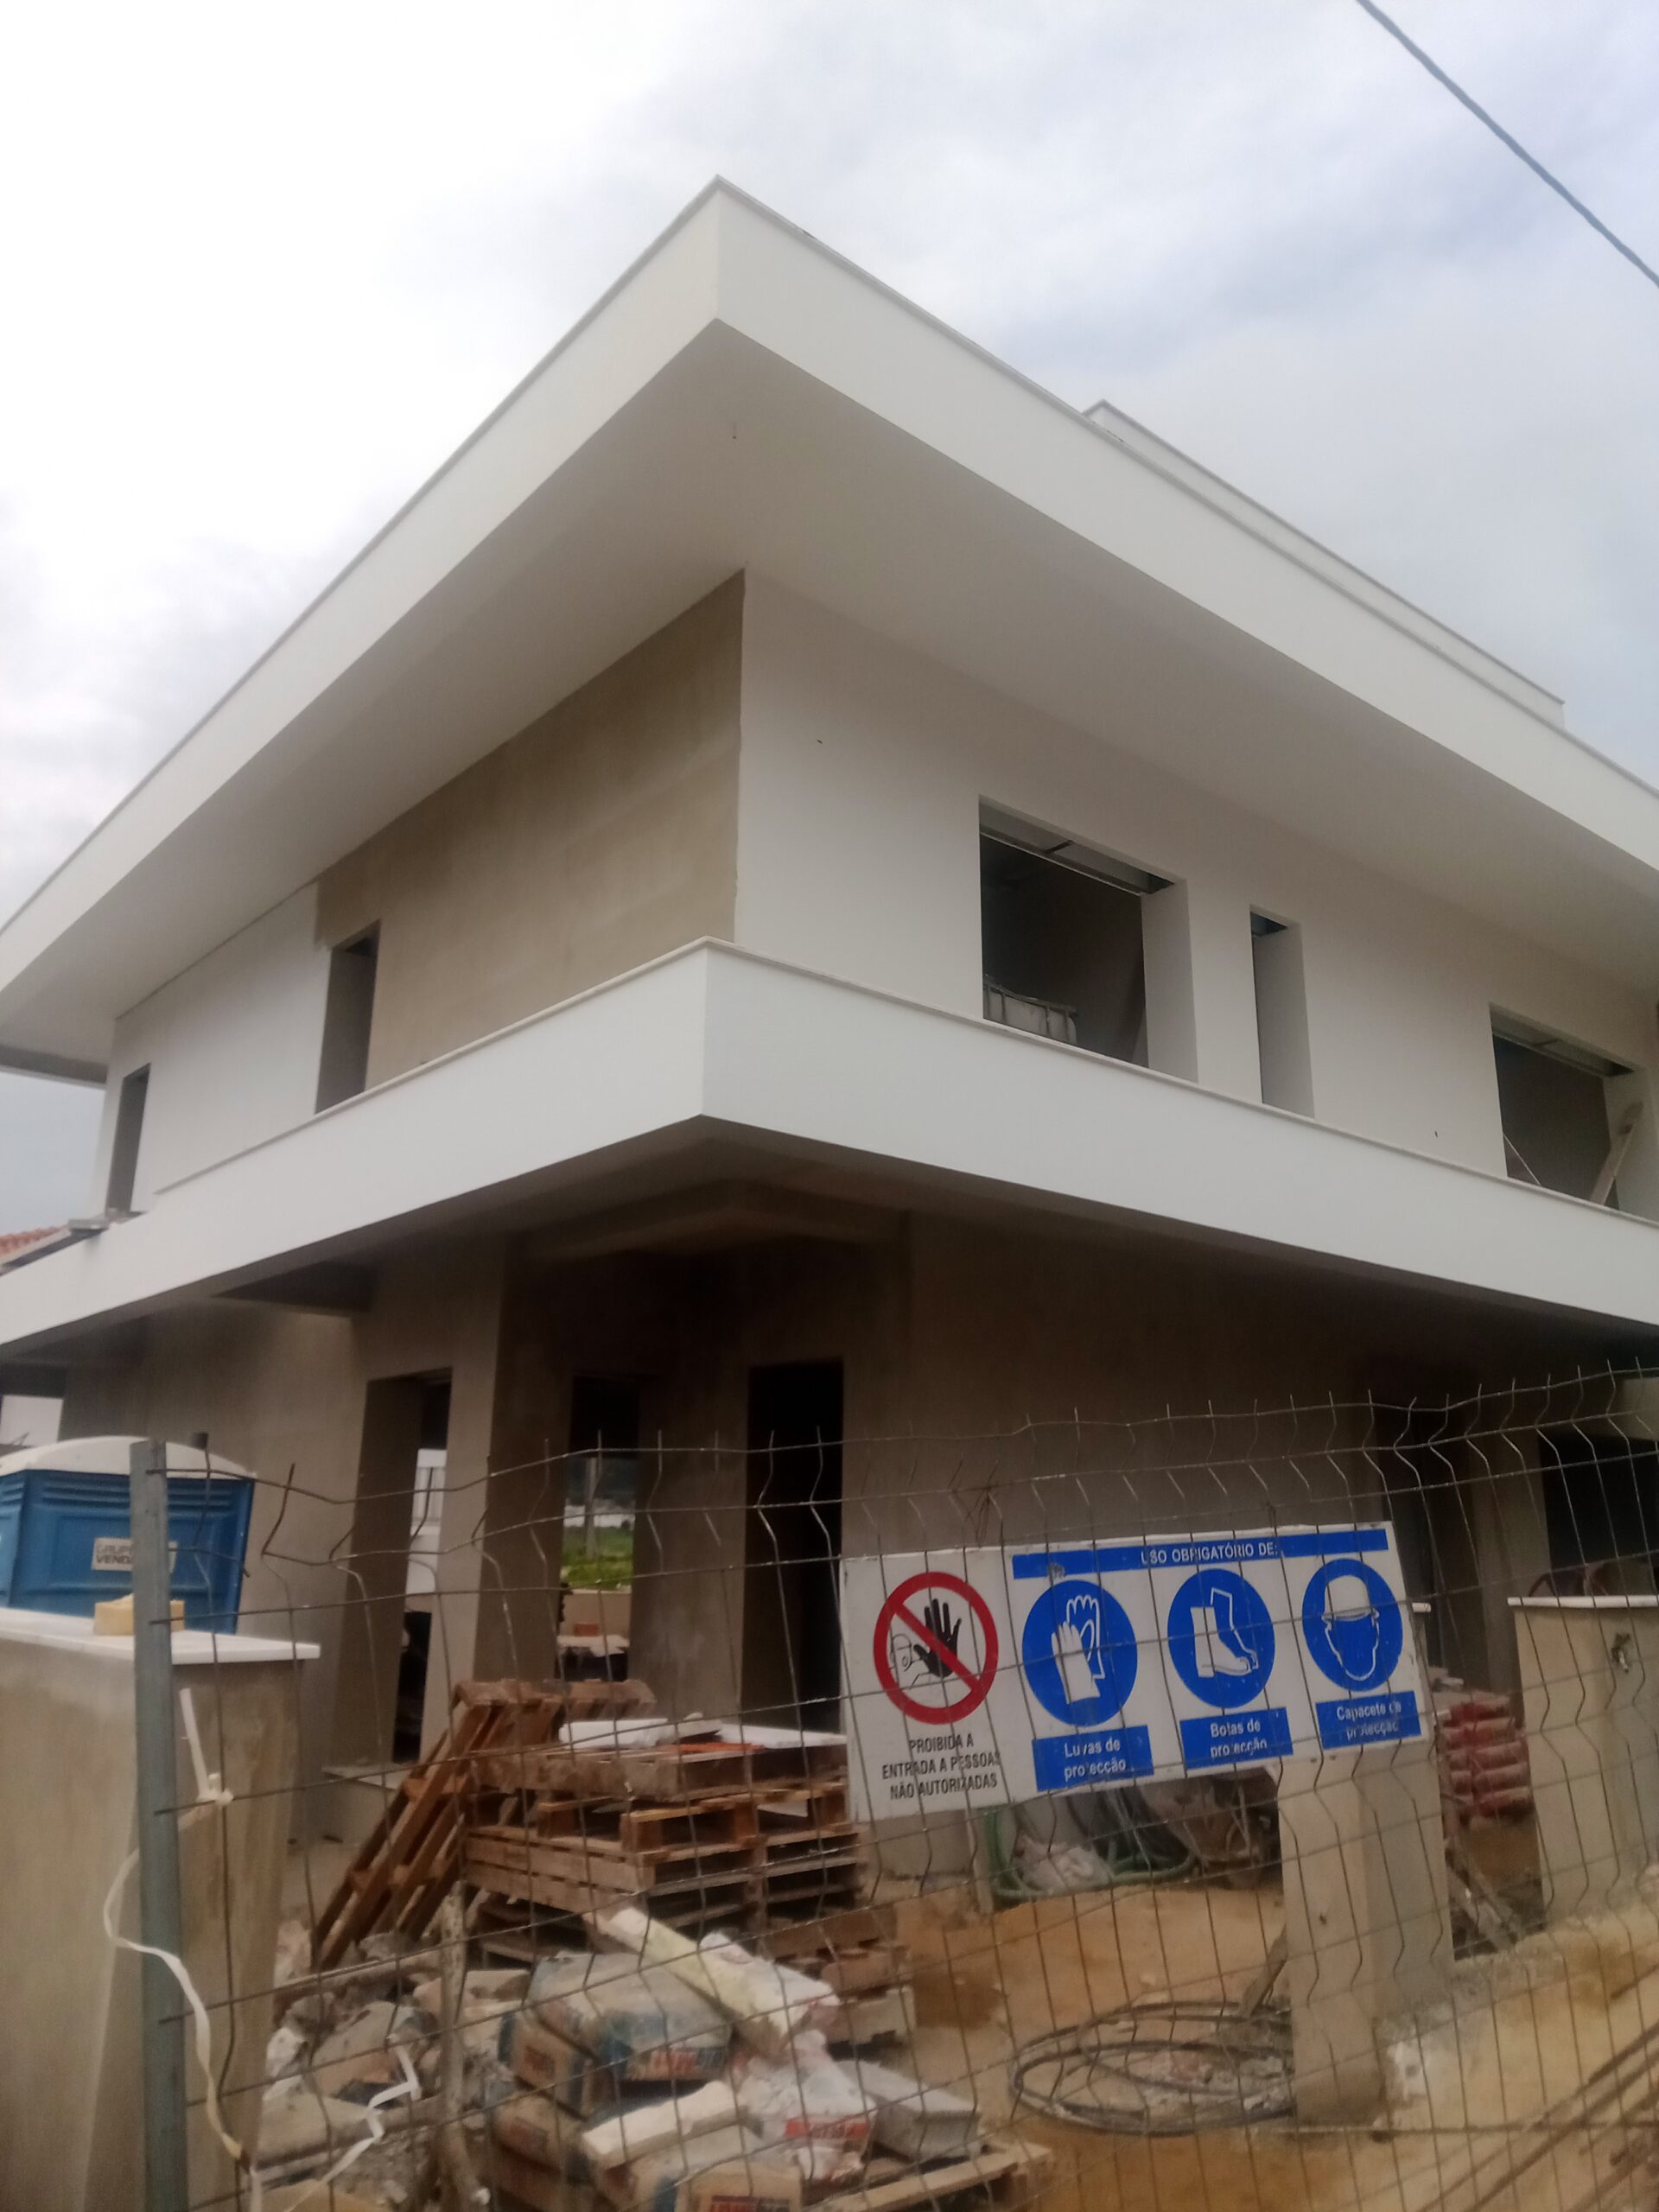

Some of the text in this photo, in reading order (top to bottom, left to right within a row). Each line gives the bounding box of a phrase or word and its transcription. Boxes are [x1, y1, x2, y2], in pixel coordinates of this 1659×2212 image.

[1172, 1542, 1254, 1562] OBRIGATÓRIO
[1337, 1702, 1386, 1721] Capacete
[1211, 1718, 1261, 1738] Botas de
[909, 1733, 974, 1753] PROIBIDA A
[1105, 1736, 1121, 1751] de
[882, 1751, 1001, 1780] ENTRADA A PESSOAS
[1065, 1757, 1127, 1783] proecção
[890, 1773, 997, 1800] NÃO AUTORIZADAS
